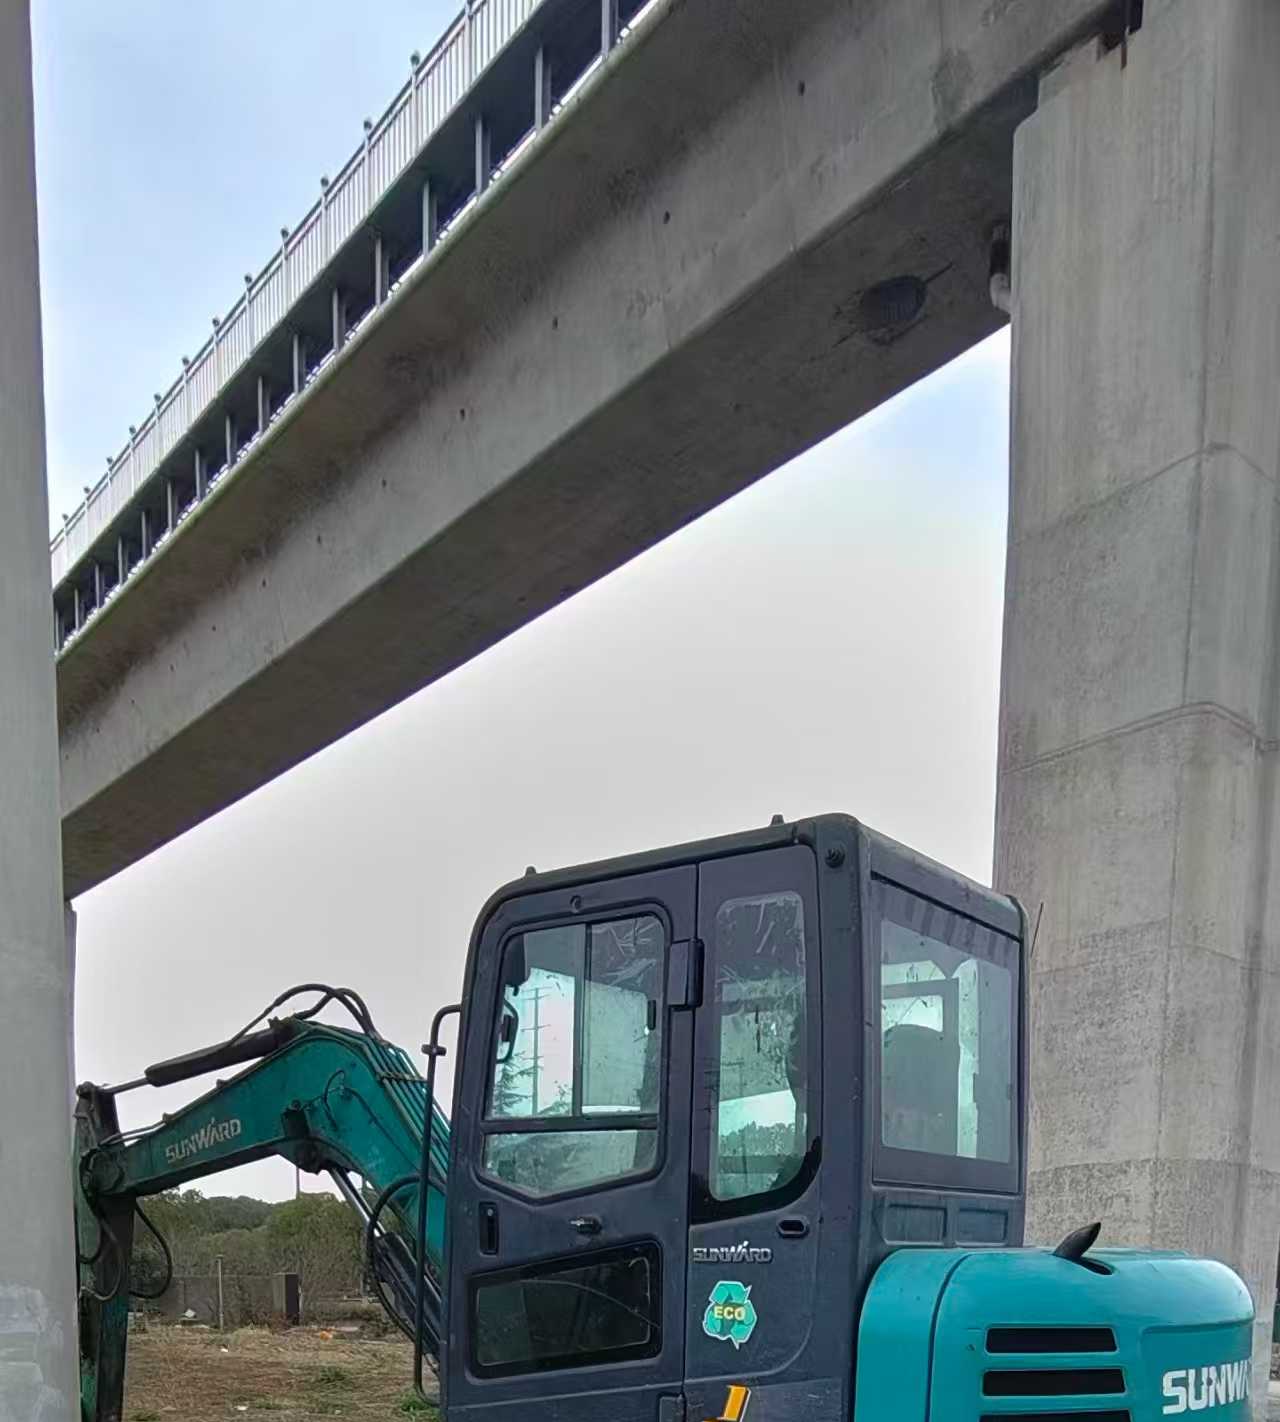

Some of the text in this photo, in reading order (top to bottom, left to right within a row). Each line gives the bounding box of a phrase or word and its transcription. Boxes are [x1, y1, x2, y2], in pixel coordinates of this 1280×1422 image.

[166, 1117, 241, 1164] SUNWARD
[693, 1241, 771, 1261] SUNWARD
[713, 1305, 746, 1320] ECO
